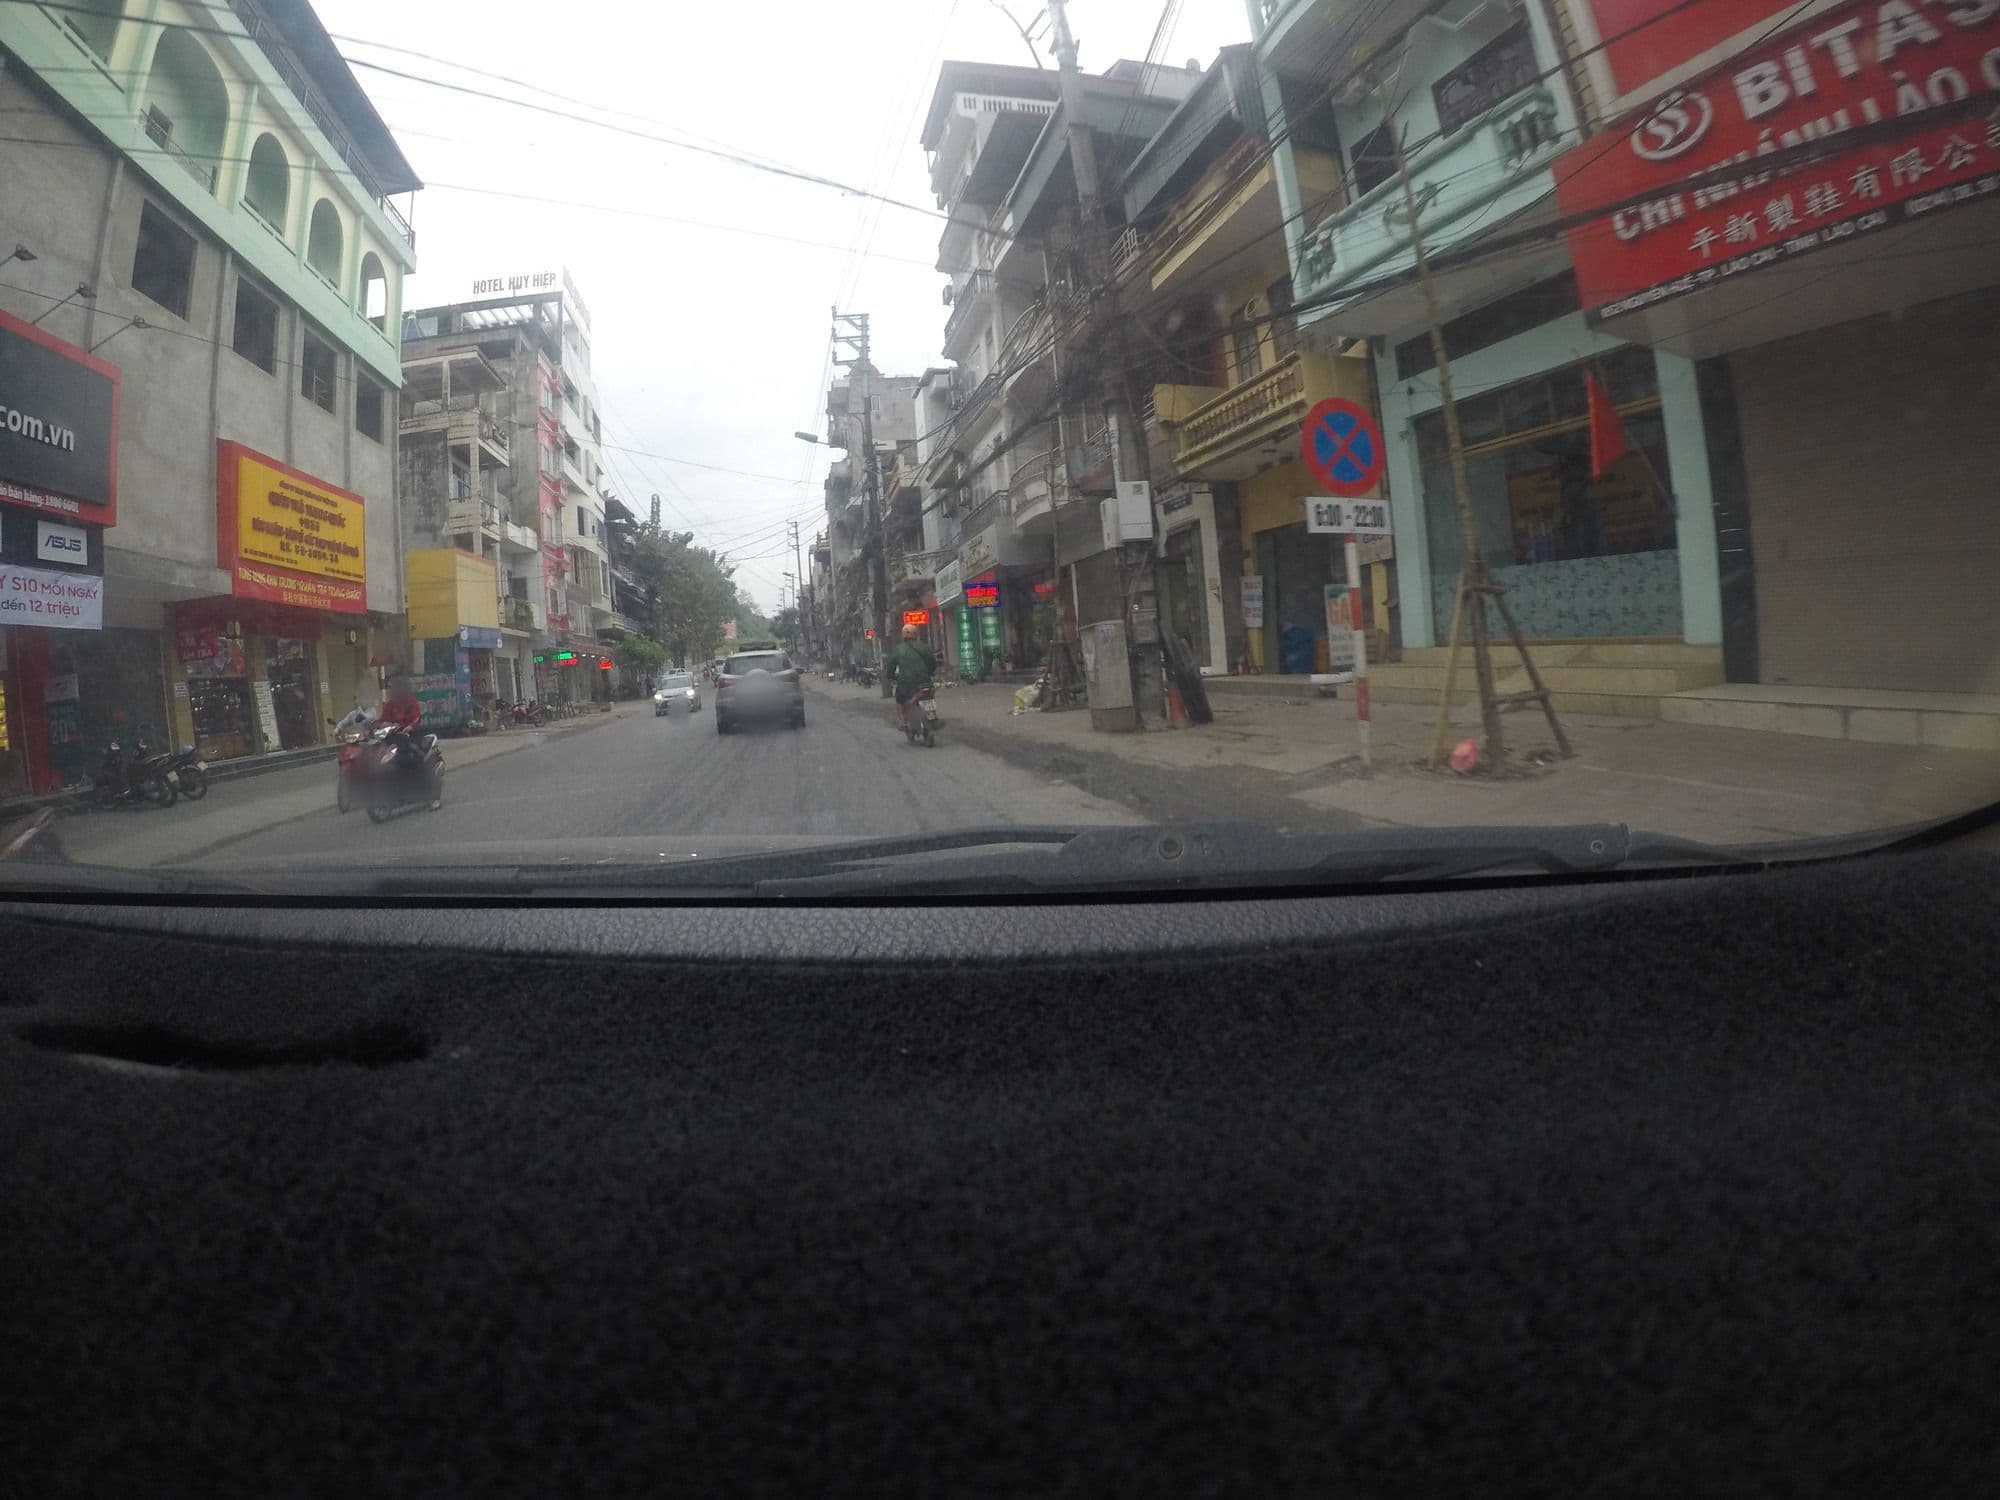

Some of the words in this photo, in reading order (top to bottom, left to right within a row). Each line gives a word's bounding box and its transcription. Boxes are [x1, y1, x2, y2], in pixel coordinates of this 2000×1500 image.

[472, 278, 505, 295] HOTEL
[508, 273, 530, 291] HUY
[532, 270, 557, 289] HIỆP
[1353, 505, 1385, 528] 22:00
[45, 534, 82, 552] ASUS
[11, 576, 38, 593] S10
[29, 599, 43, 614] 12
[46, 600, 81, 620] triệu
